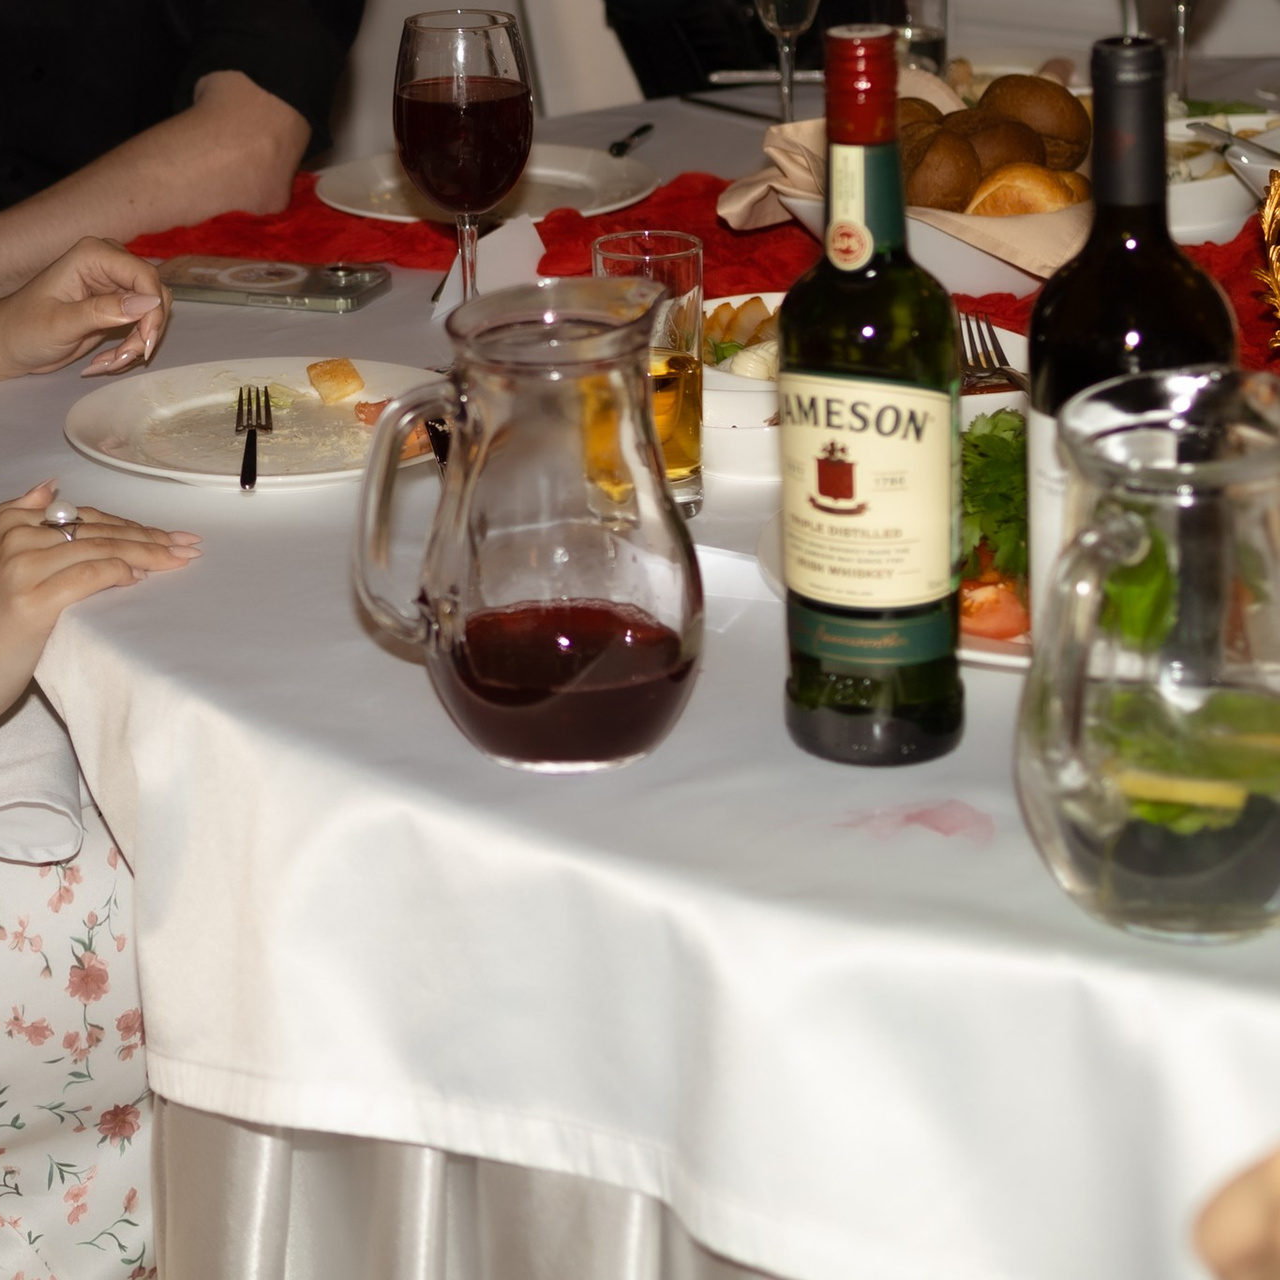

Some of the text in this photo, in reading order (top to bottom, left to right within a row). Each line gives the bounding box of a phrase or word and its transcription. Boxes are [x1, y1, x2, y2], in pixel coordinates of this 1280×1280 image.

[781, 392, 928, 442] AMESON
[828, 526, 903, 539] DISTILLED
[828, 566, 895, 579] WHISKEY
